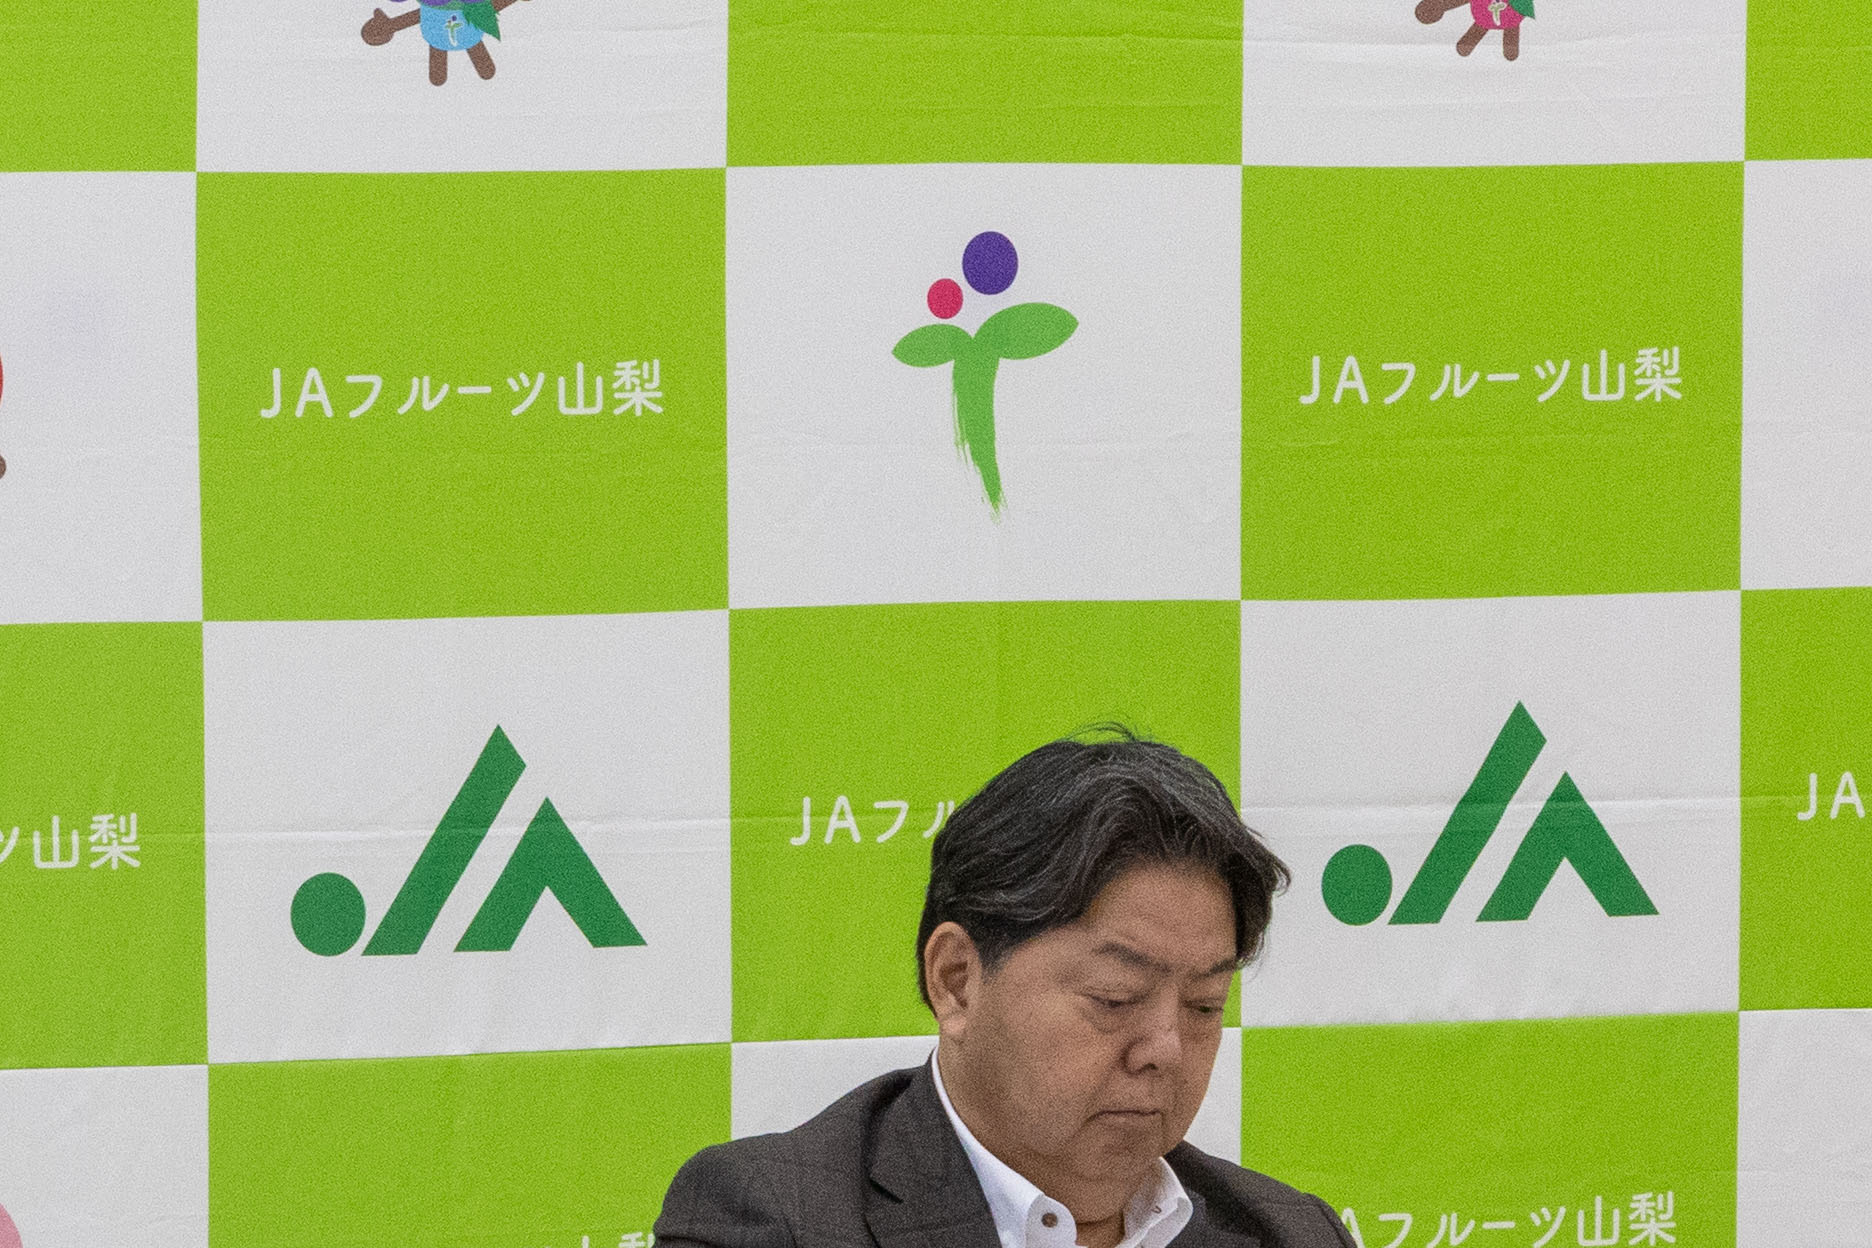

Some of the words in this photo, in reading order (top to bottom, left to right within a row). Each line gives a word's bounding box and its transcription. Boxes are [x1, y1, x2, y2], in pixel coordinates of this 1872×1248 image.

[259, 358, 665, 419] JAフルーツ山梨
[1299, 346, 1683, 405] JAフルーツ山梨
